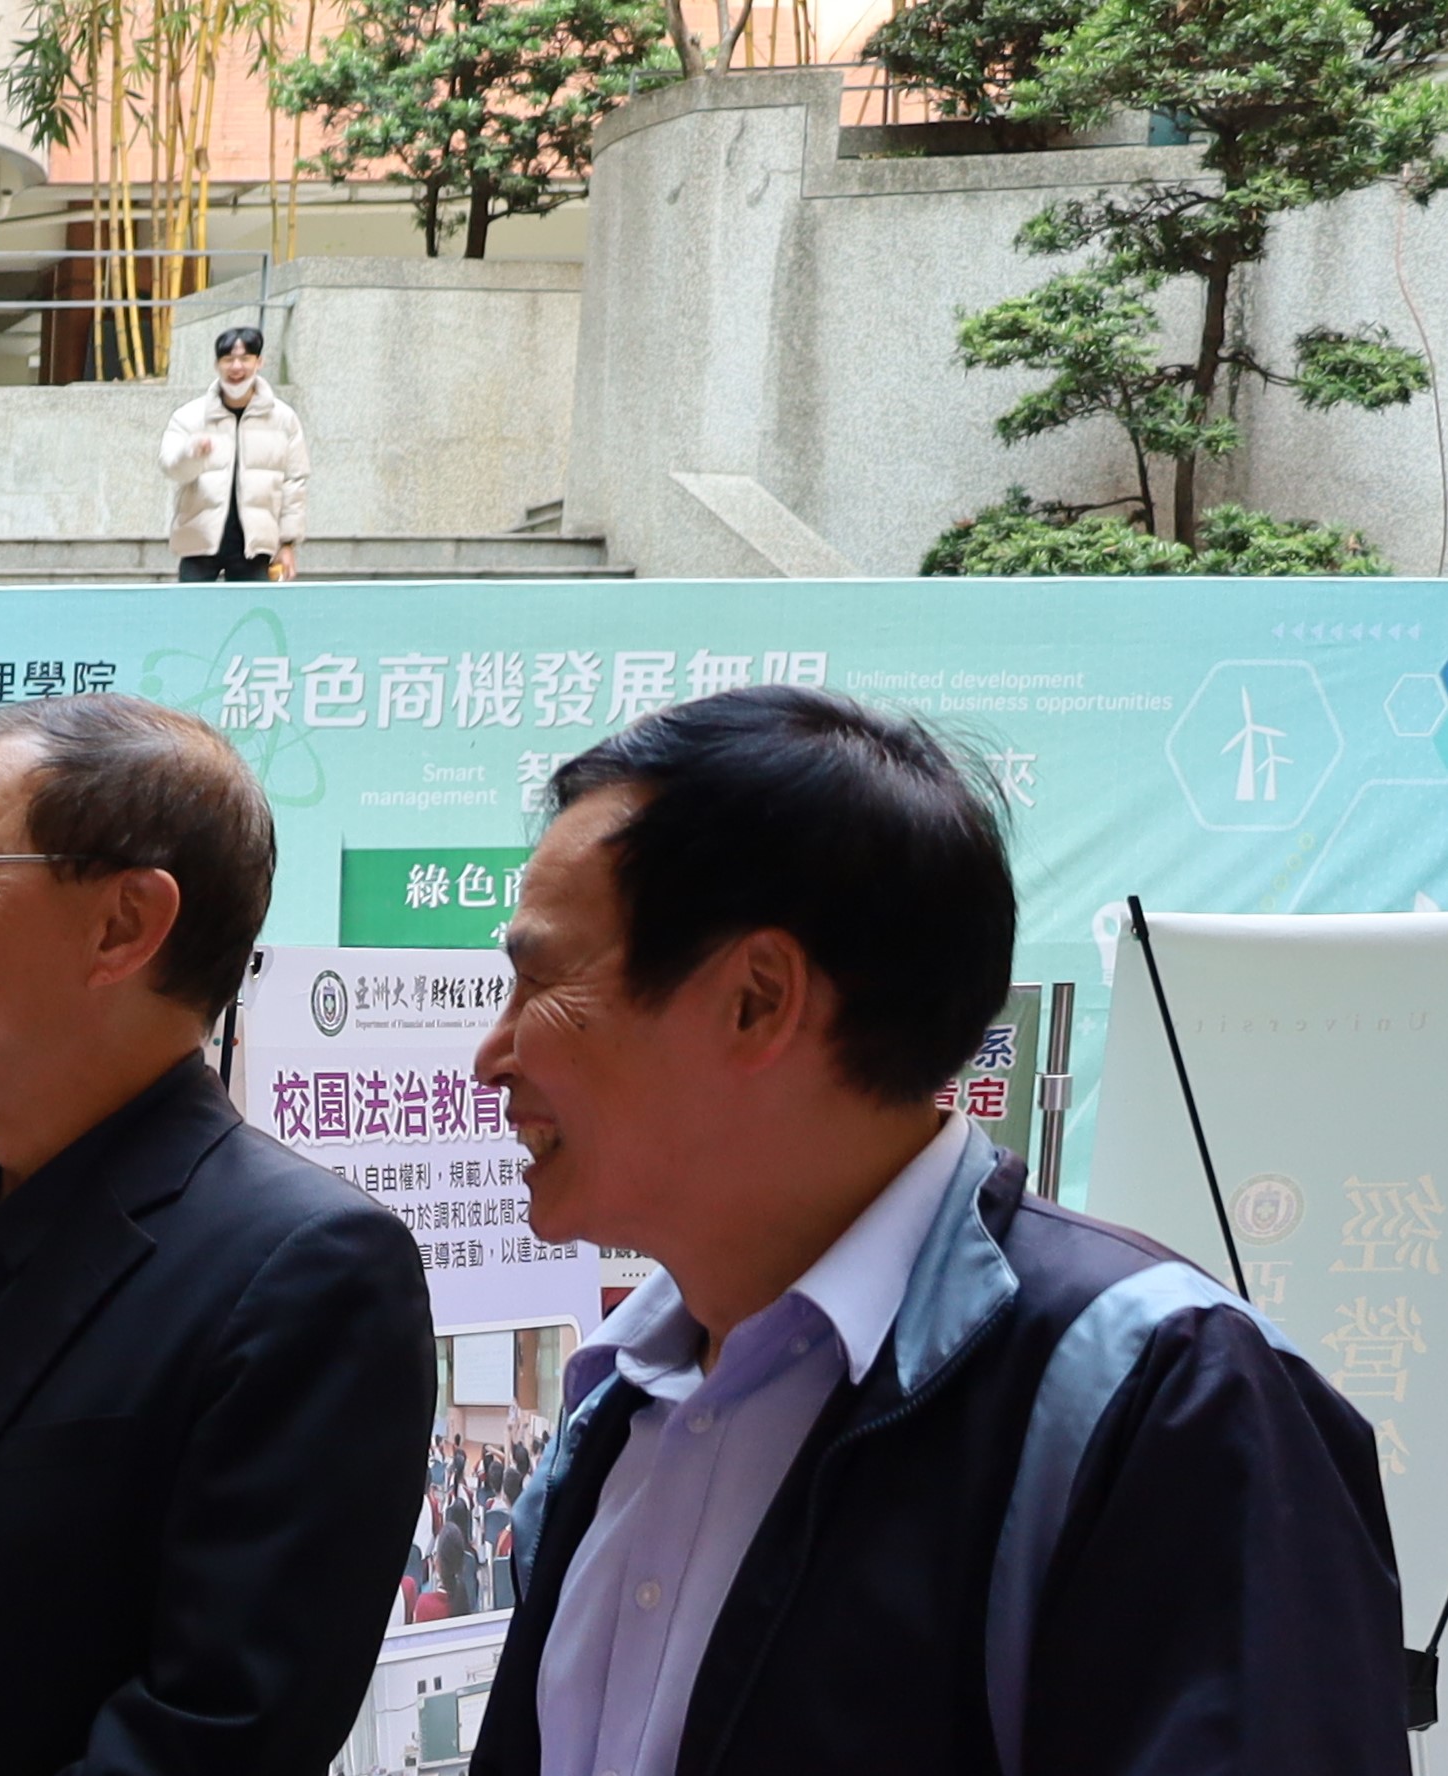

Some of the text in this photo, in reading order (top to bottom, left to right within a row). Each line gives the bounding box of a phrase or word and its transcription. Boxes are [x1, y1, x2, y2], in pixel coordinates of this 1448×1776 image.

[846, 671, 1085, 693] Unlimited development
[940, 693, 1029, 712] business
[1036, 692, 1174, 714] opportunities
[423, 763, 486, 783] Smart
[360, 787, 498, 808] management
[272, 1069, 522, 1139] 校園法治教育
